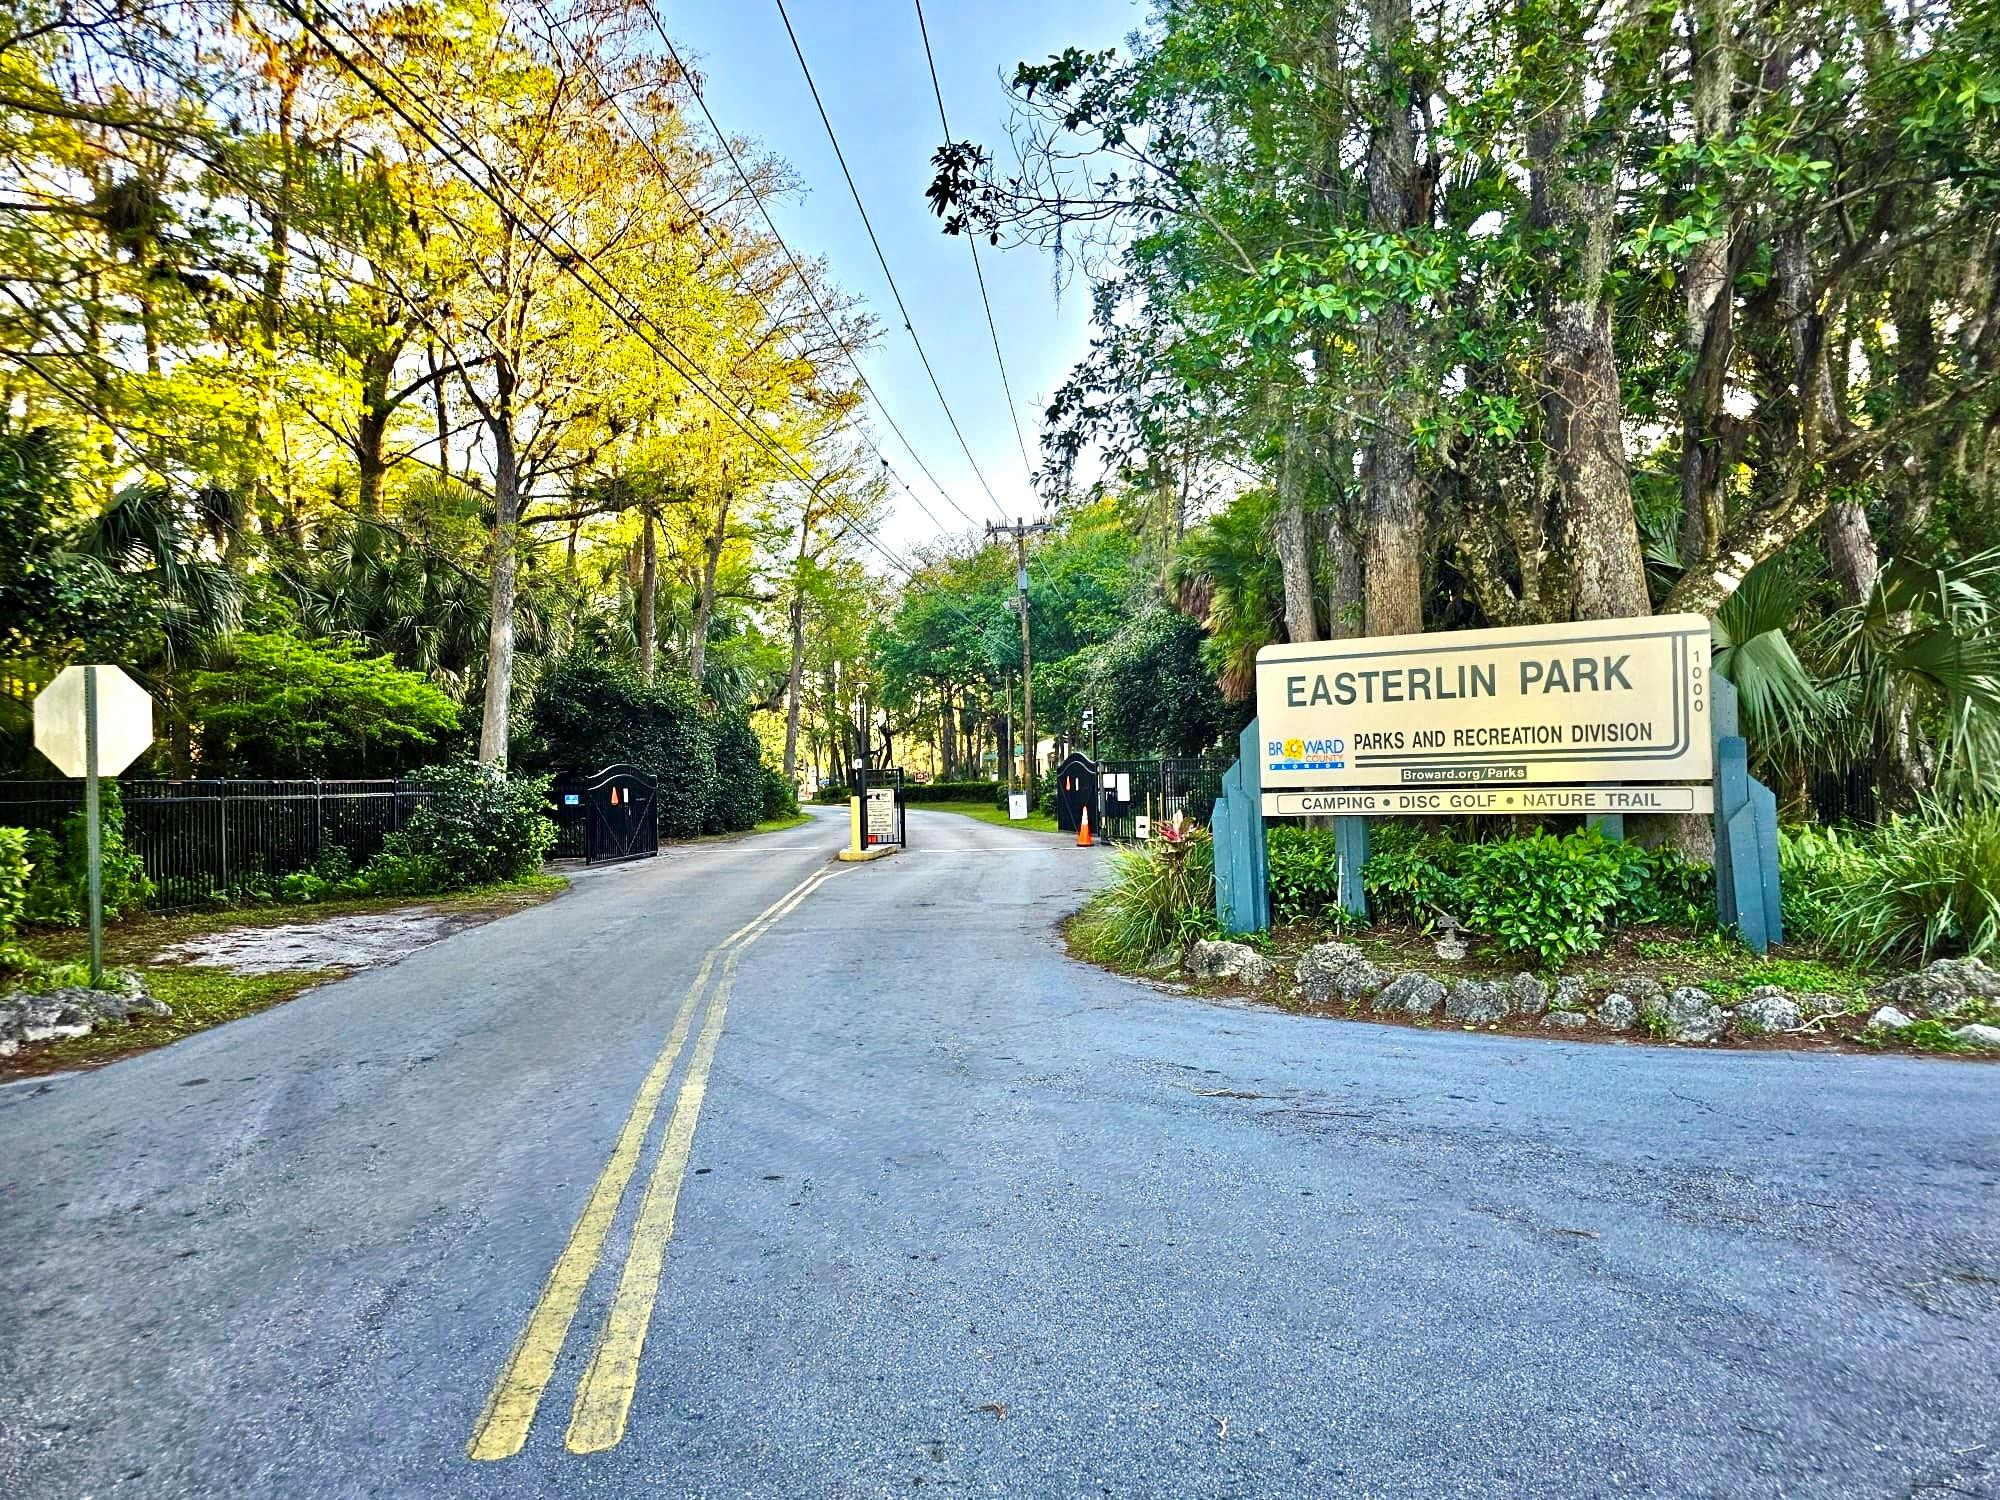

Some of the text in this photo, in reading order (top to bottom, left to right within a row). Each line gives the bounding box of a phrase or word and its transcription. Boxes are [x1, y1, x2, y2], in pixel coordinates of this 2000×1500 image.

[1287, 655, 1633, 707] EASTERLIN PARK
[1692, 650, 1704, 713] 1000
[1354, 722, 1652, 750] PARKS AND RECREATION DIVISION
[1268, 739, 1344, 757] BROWARD
[1306, 754, 1344, 763] COUNTY
[1403, 767, 1525, 781] Broward.org/Parks
[1302, 793, 1662, 810] CAMPING DISC GOLF NATURE TRAIL
